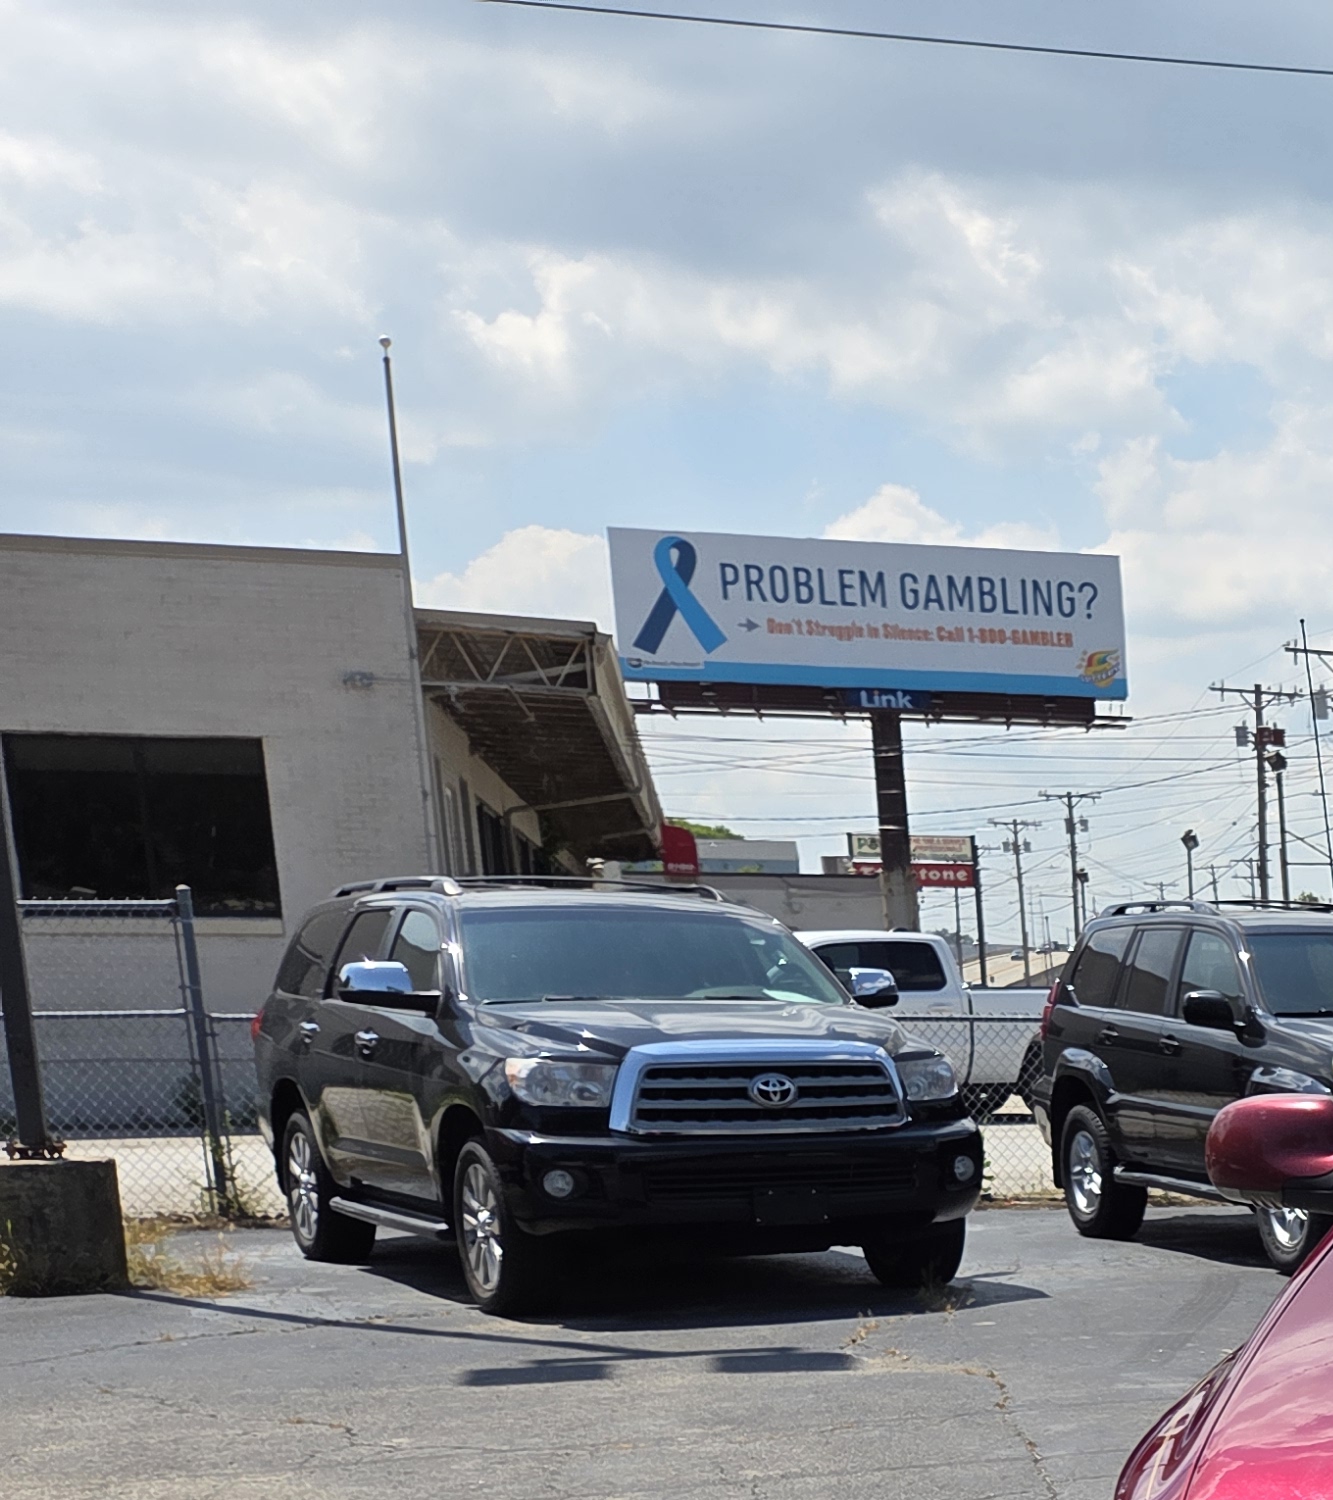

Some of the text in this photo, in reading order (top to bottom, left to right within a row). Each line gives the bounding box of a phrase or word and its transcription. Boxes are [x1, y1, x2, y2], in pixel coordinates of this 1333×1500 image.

[719, 562, 1099, 620] PROBLEM GAMBLING?
[936, 626, 965, 642] Call
[967, 627, 1074, 648] 1-800-GAMBLER
[859, 689, 913, 709] Link
